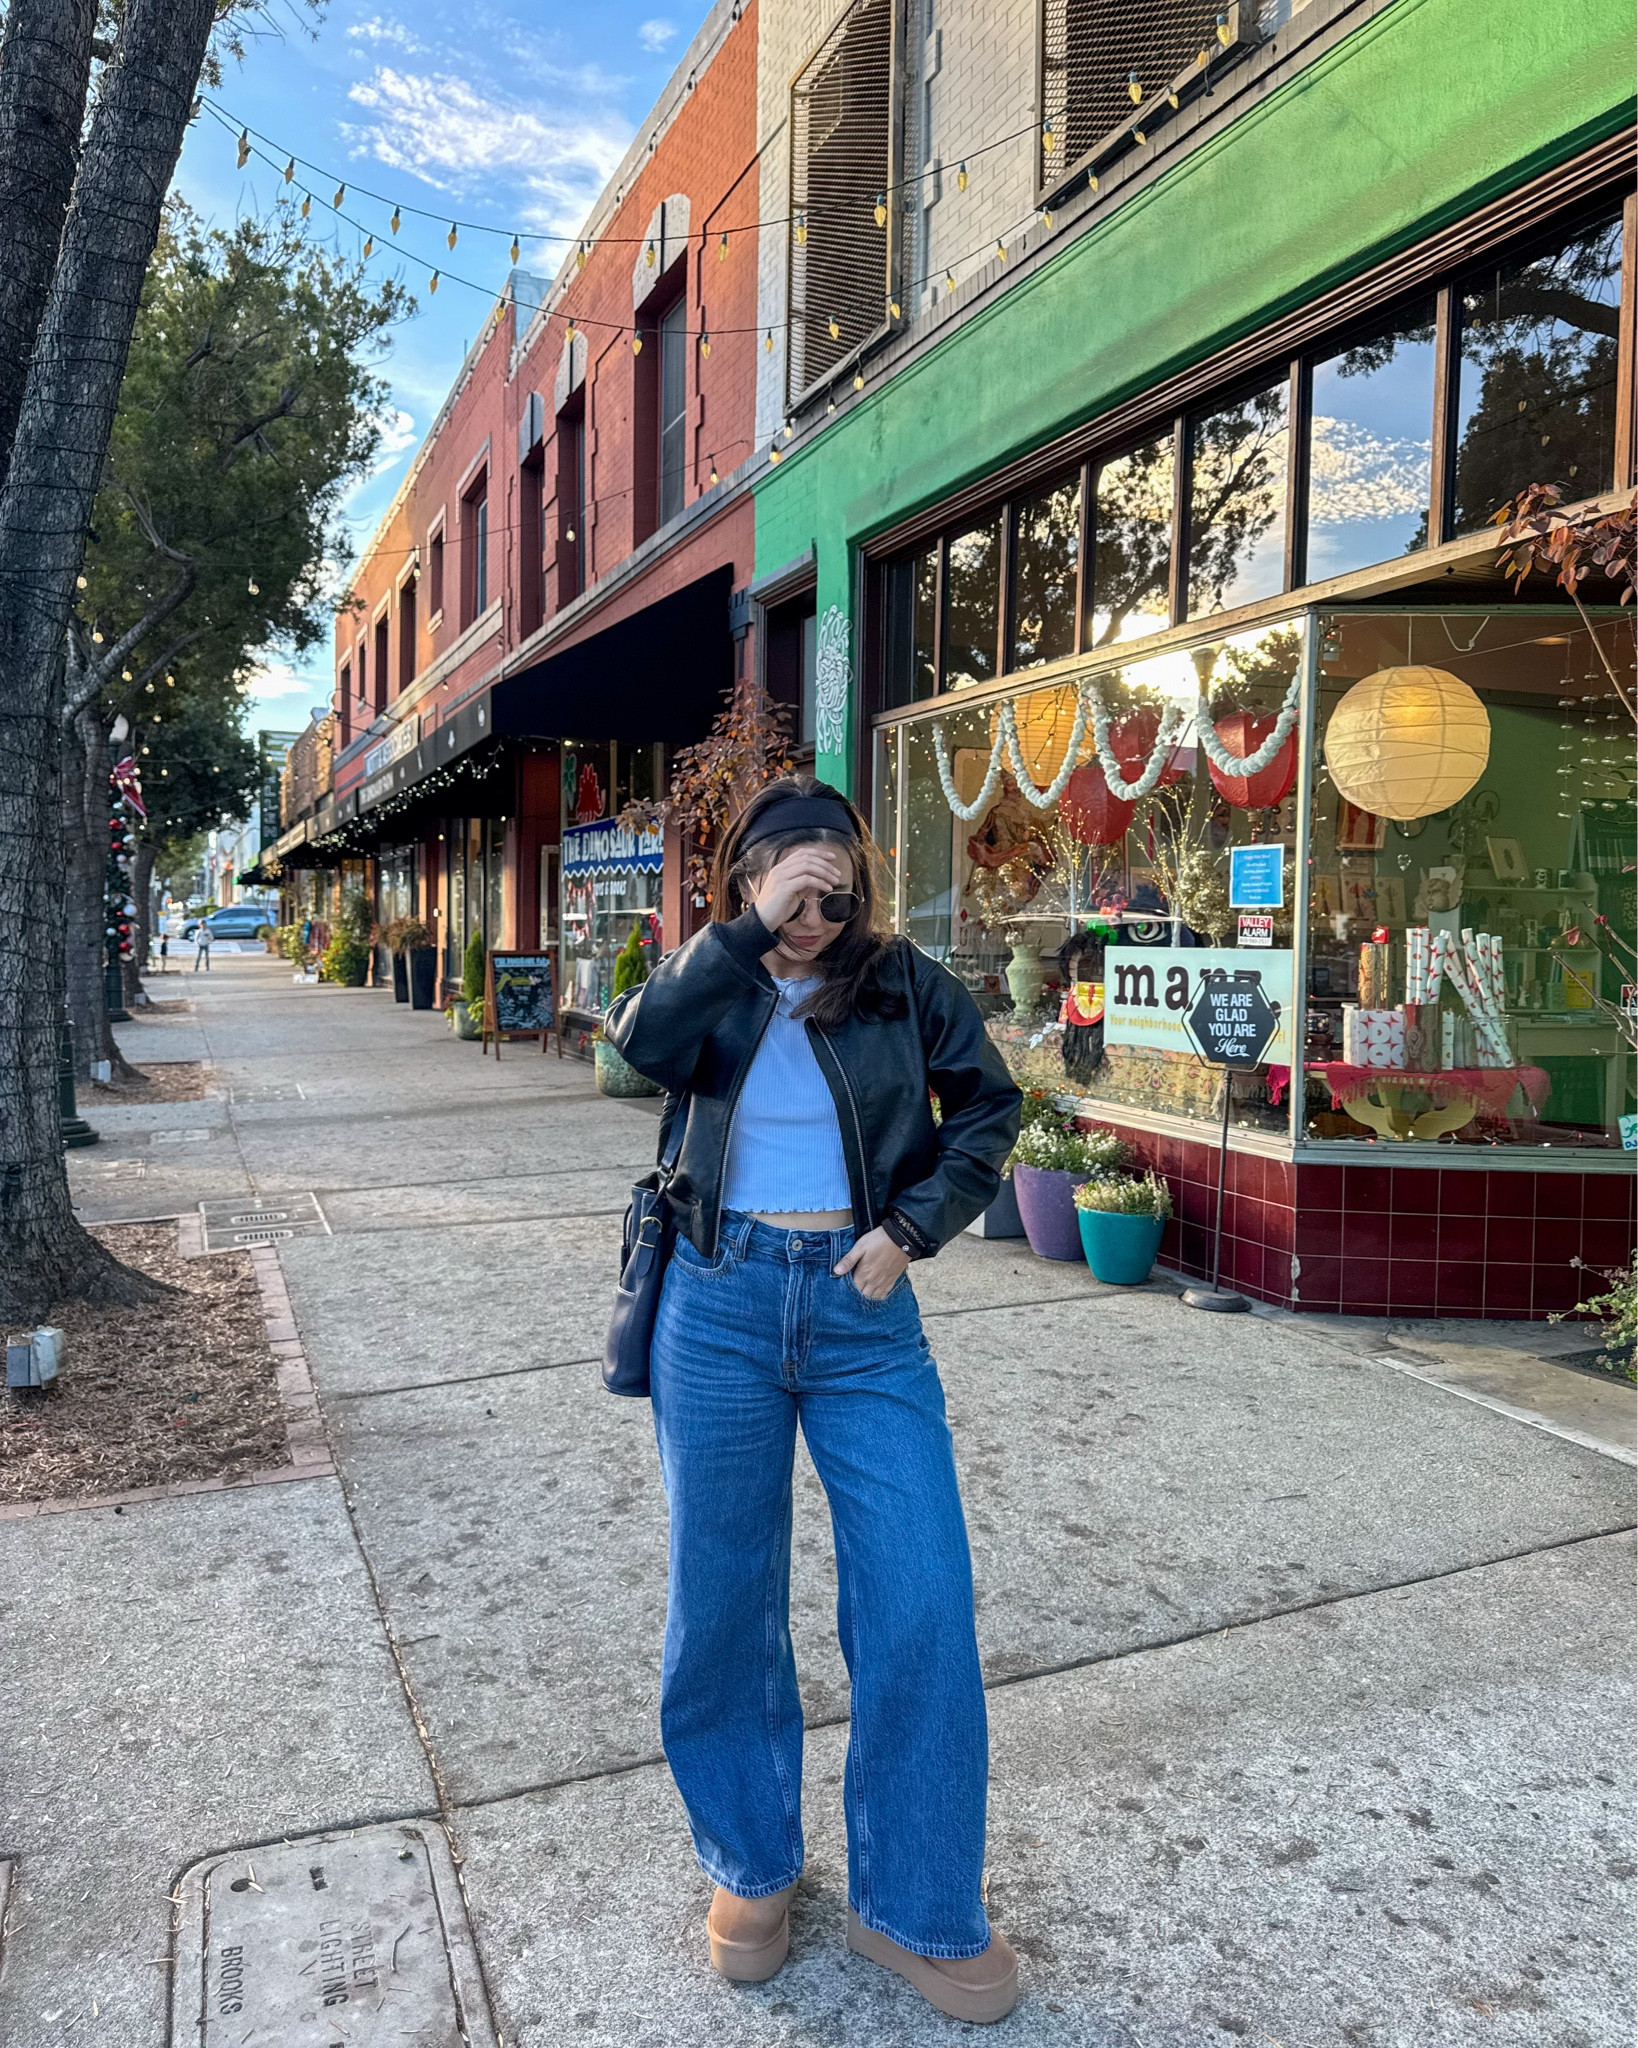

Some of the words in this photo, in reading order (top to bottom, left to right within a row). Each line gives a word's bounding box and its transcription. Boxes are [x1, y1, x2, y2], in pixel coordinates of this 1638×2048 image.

[1242, 918, 1269, 927] VALLEY
[1242, 928, 1268, 937] ALARM
[1210, 993, 1229, 1007] WE
[1230, 993, 1253, 1007] ARE
[1110, 1014, 1125, 1026] Your
[1215, 1008, 1248, 1022] GLAD
[1208, 1022, 1232, 1037] YOU
[1233, 1023, 1257, 1037] ARE
[1214, 1037, 1251, 1057] Here
[351, 1920, 379, 1989] STREET
[319, 1919, 349, 2008] LIGHTING
[219, 1945, 243, 2015] BROOKS
